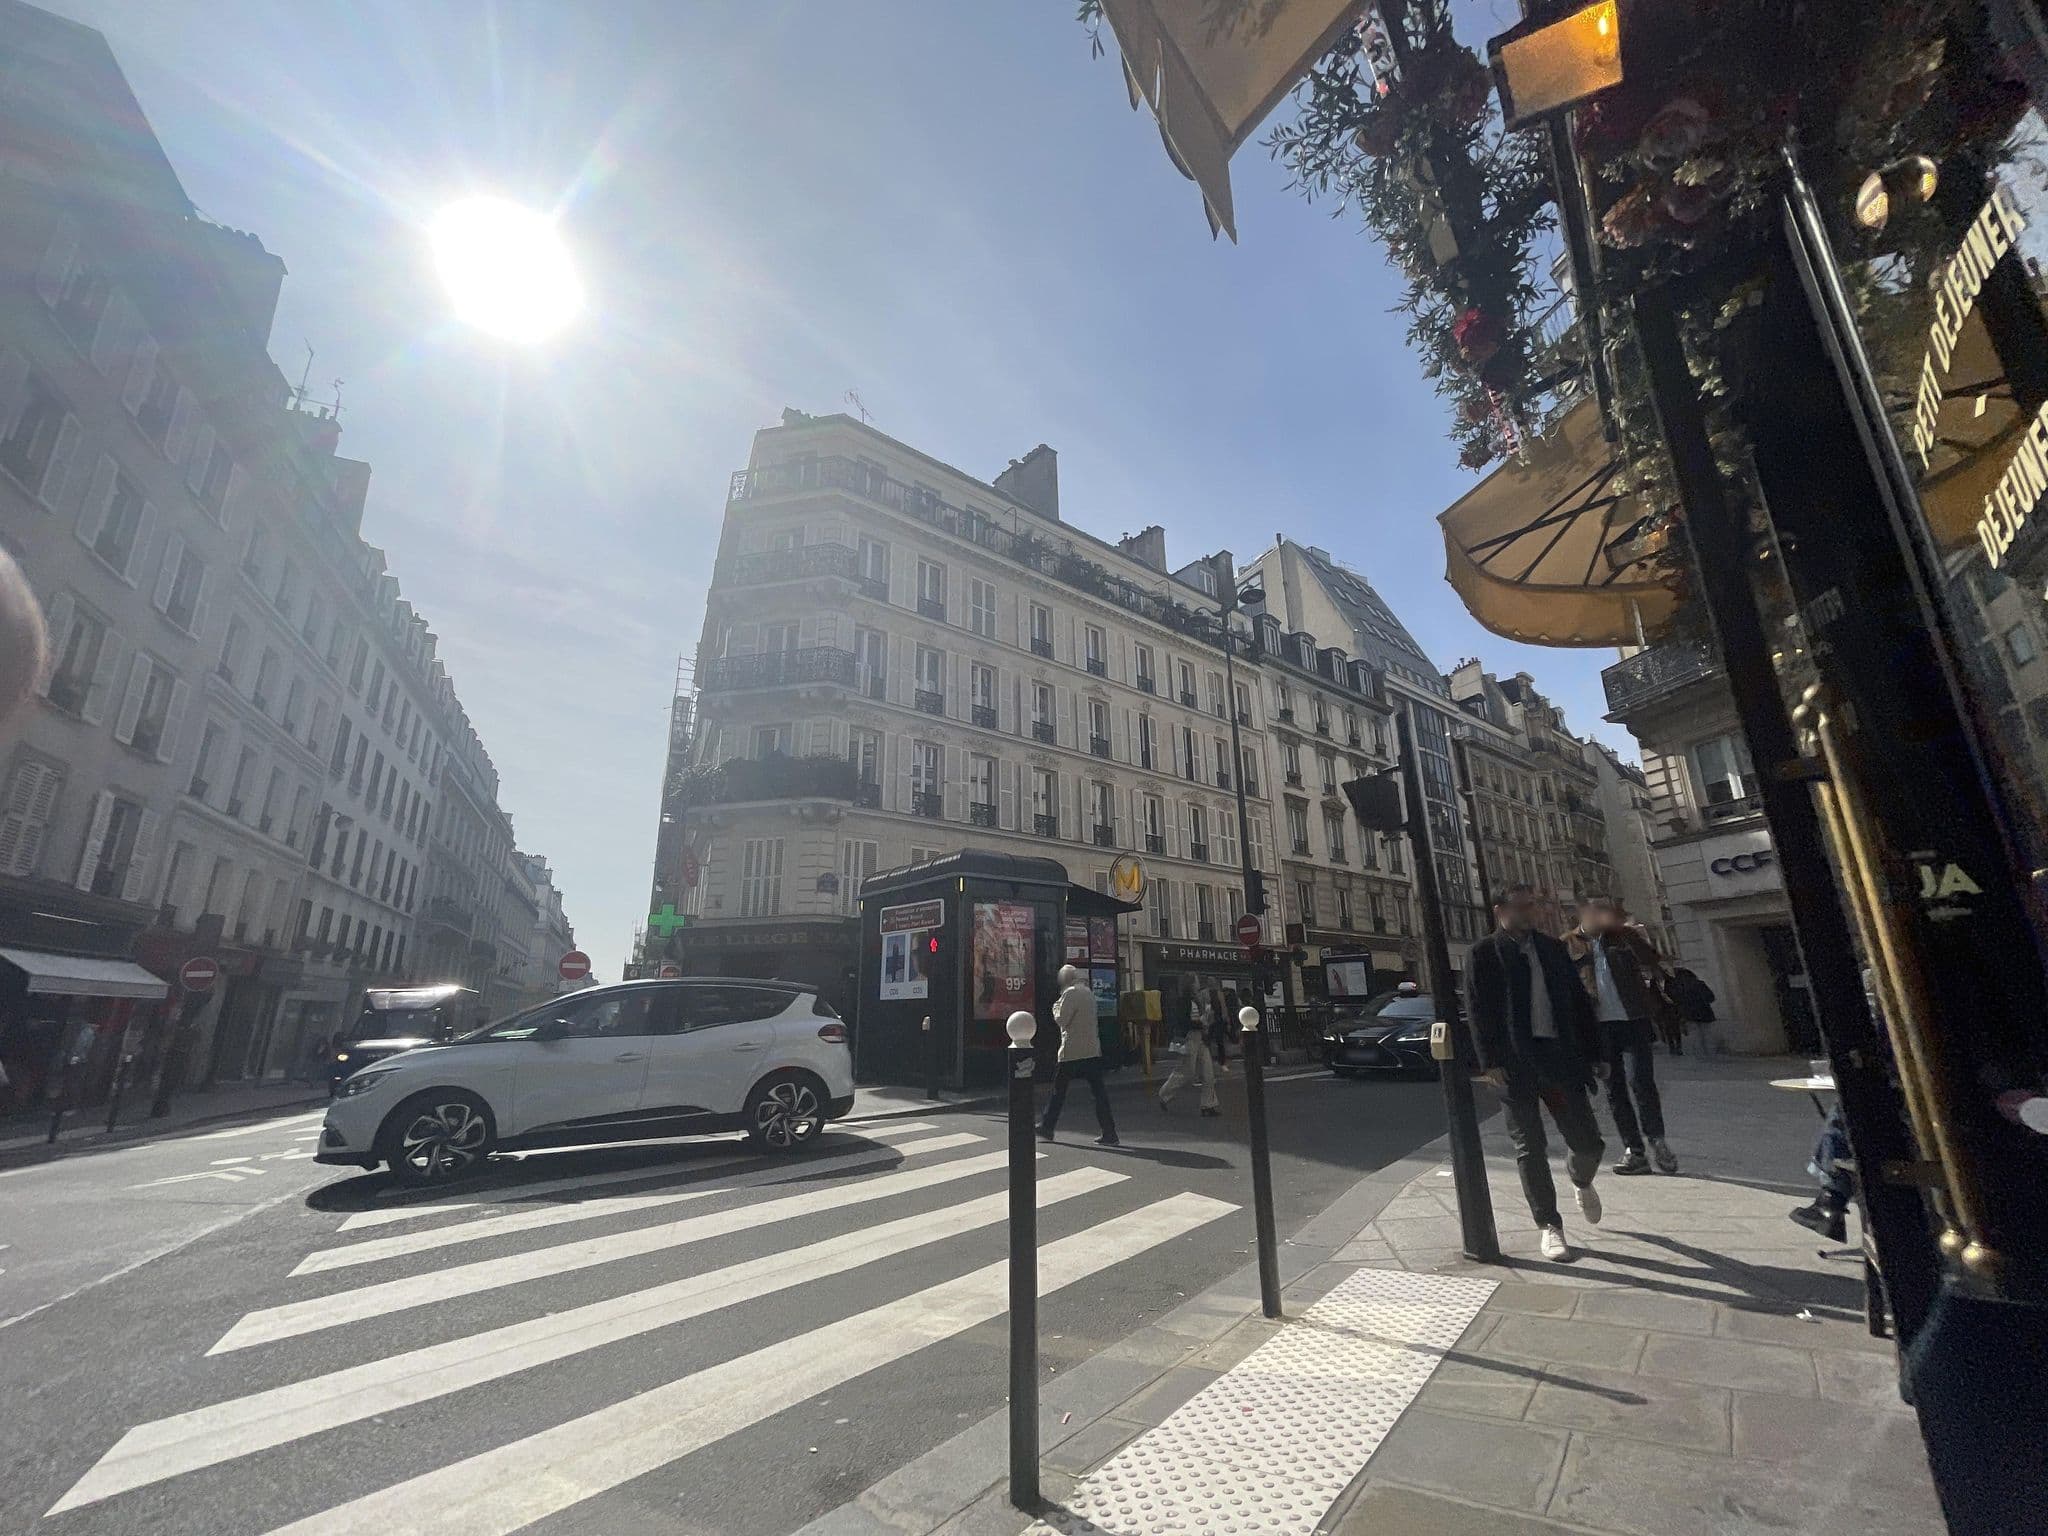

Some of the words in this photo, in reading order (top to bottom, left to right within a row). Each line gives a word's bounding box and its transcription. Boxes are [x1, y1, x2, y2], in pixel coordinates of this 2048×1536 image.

[1913, 350, 1942, 470] PETIT
[1977, 400, 2048, 569] DÉJEUNE
[1115, 863, 1140, 896] M
[1180, 948, 1238, 961] PHARMACIE
